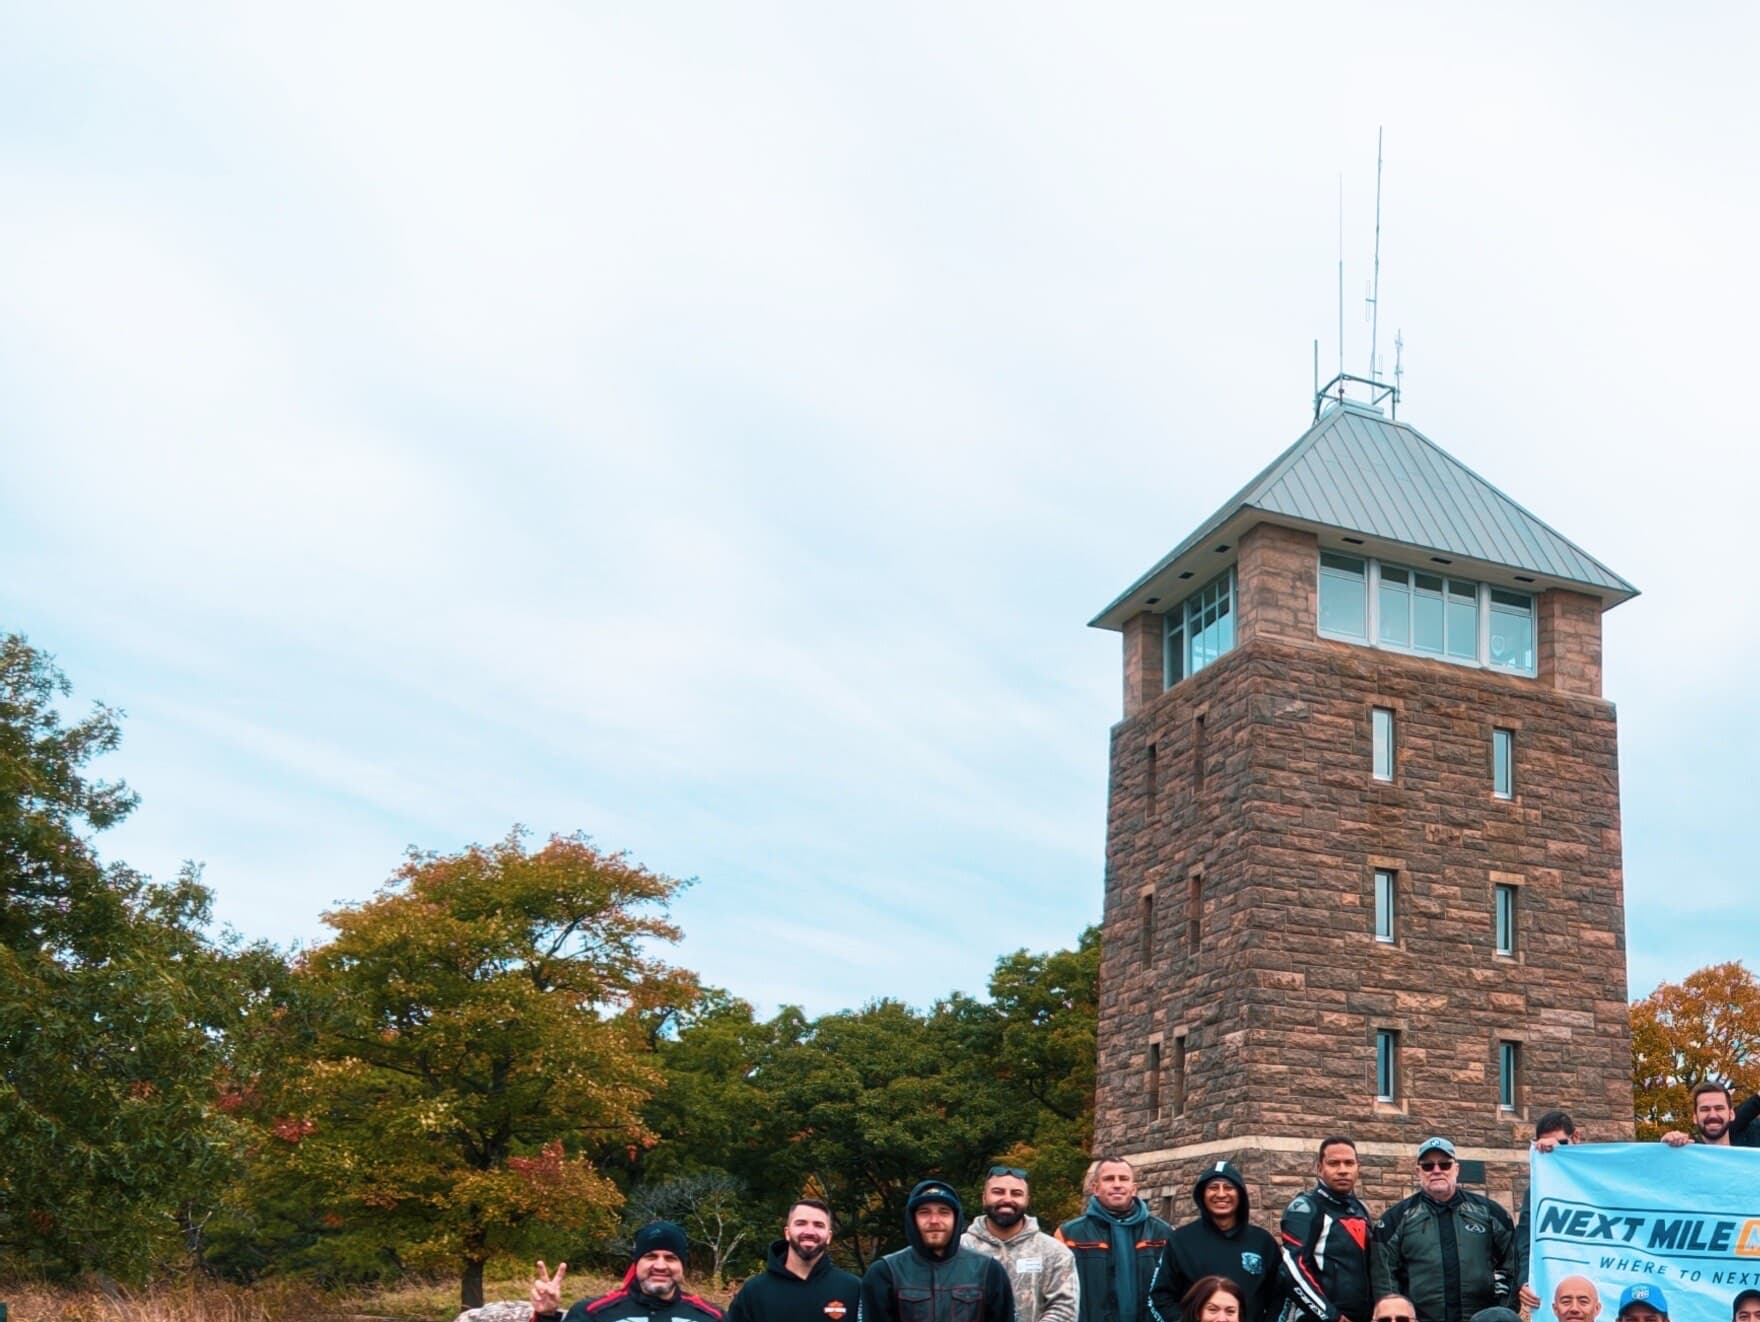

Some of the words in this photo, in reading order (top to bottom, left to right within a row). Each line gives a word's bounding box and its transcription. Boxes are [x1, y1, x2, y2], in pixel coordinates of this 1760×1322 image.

[1539, 1205, 1645, 1244] NEXT
[1647, 1218, 1737, 1252] MILE
[1599, 1256, 1670, 1275] WHERE
[1680, 1269, 1701, 1283] TO
